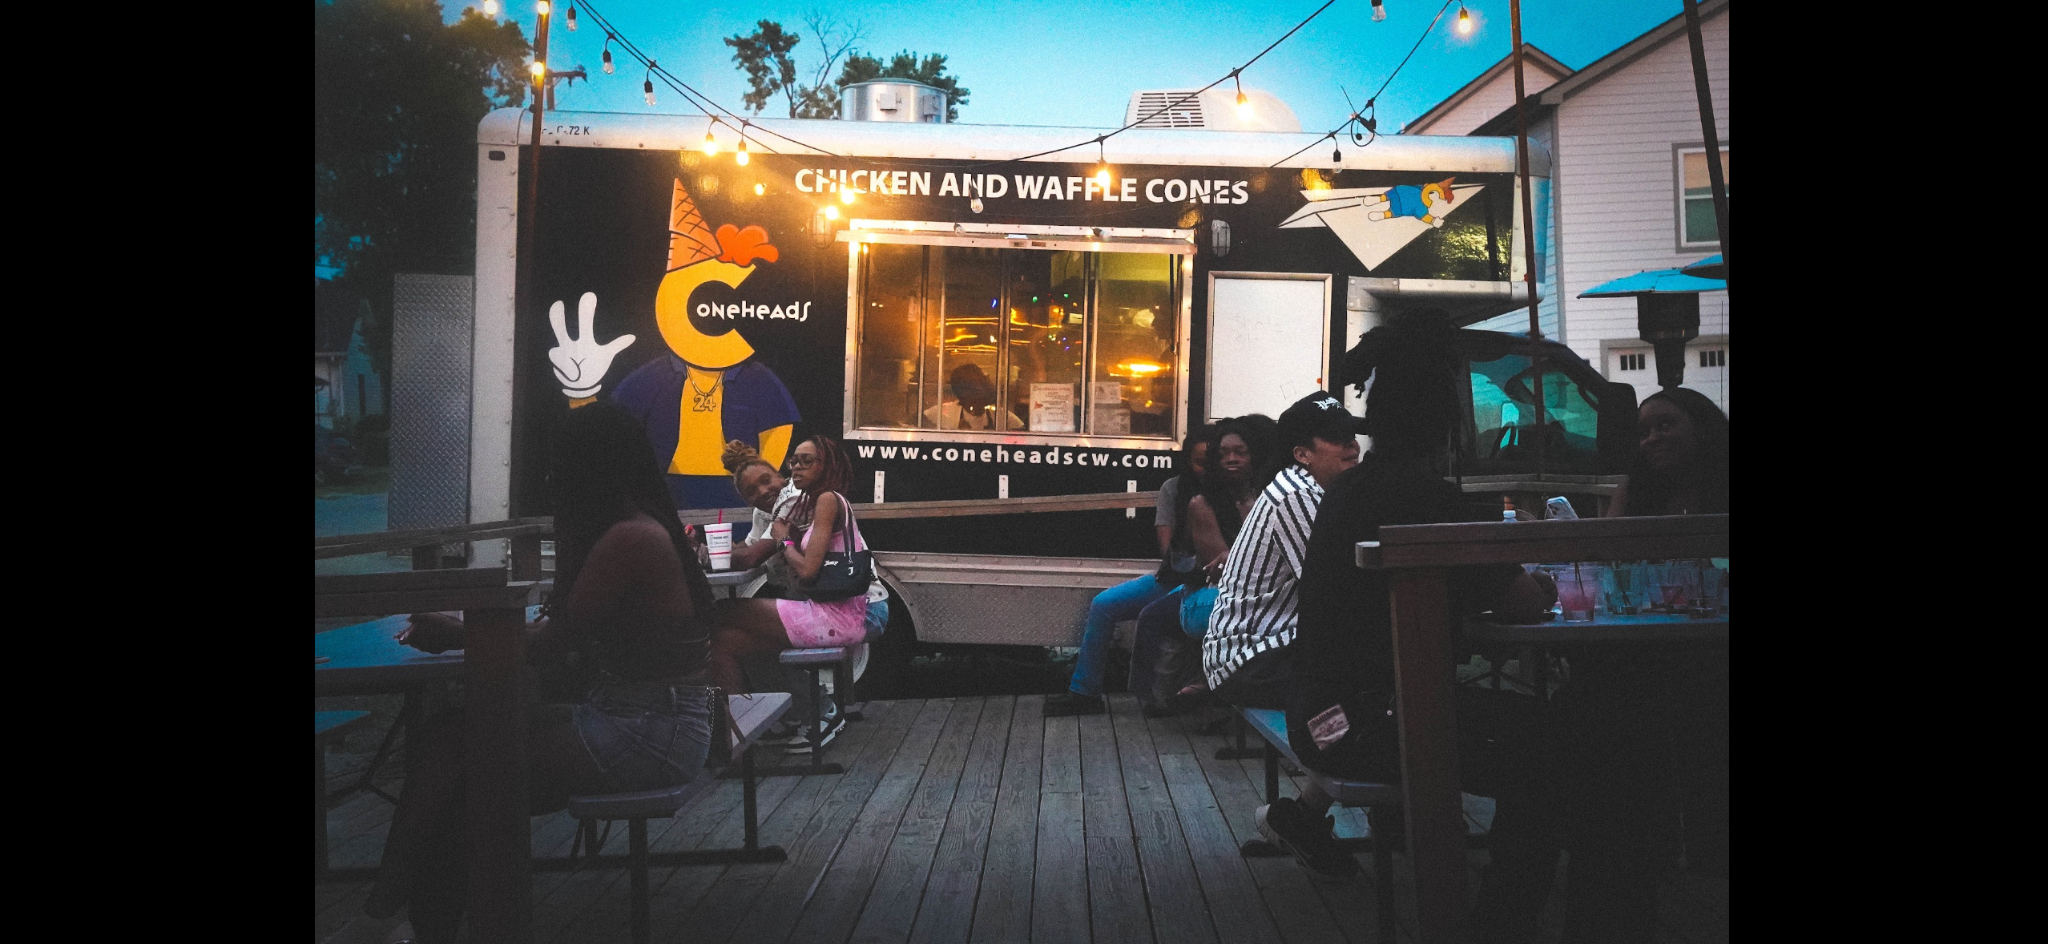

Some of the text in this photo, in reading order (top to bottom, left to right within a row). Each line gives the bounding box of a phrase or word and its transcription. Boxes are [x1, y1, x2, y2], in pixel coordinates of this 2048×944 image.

[795, 168, 1249, 205] CHICKEN AND WAFFLE CONES
[693, 395, 717, 412] 24
[857, 445, 1173, 469] www.coneheadscw.com
